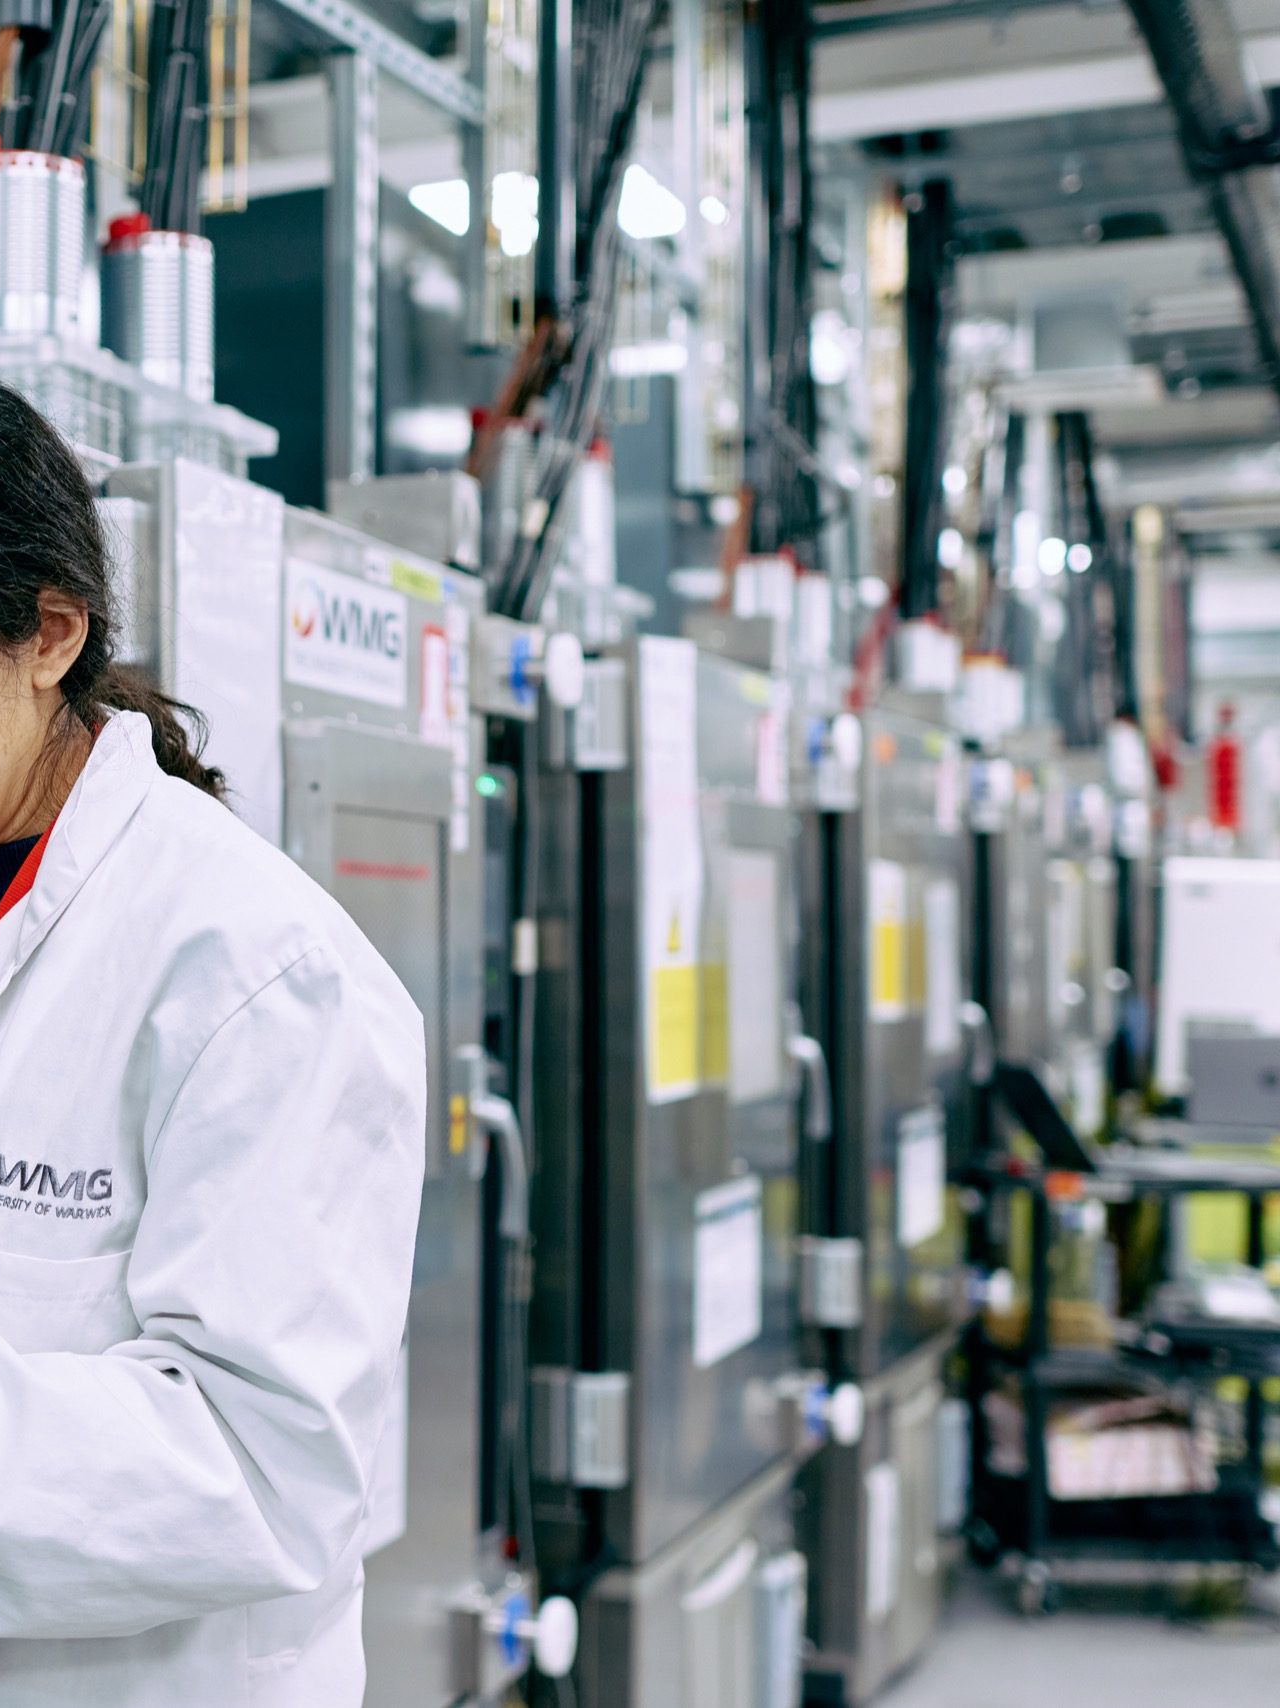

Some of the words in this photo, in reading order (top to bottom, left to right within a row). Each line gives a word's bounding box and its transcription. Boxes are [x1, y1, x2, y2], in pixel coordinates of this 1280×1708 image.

[317, 588, 401, 660] WMG
[34, 1201, 52, 1216] OF
[55, 1204, 113, 1220] WARWICK
